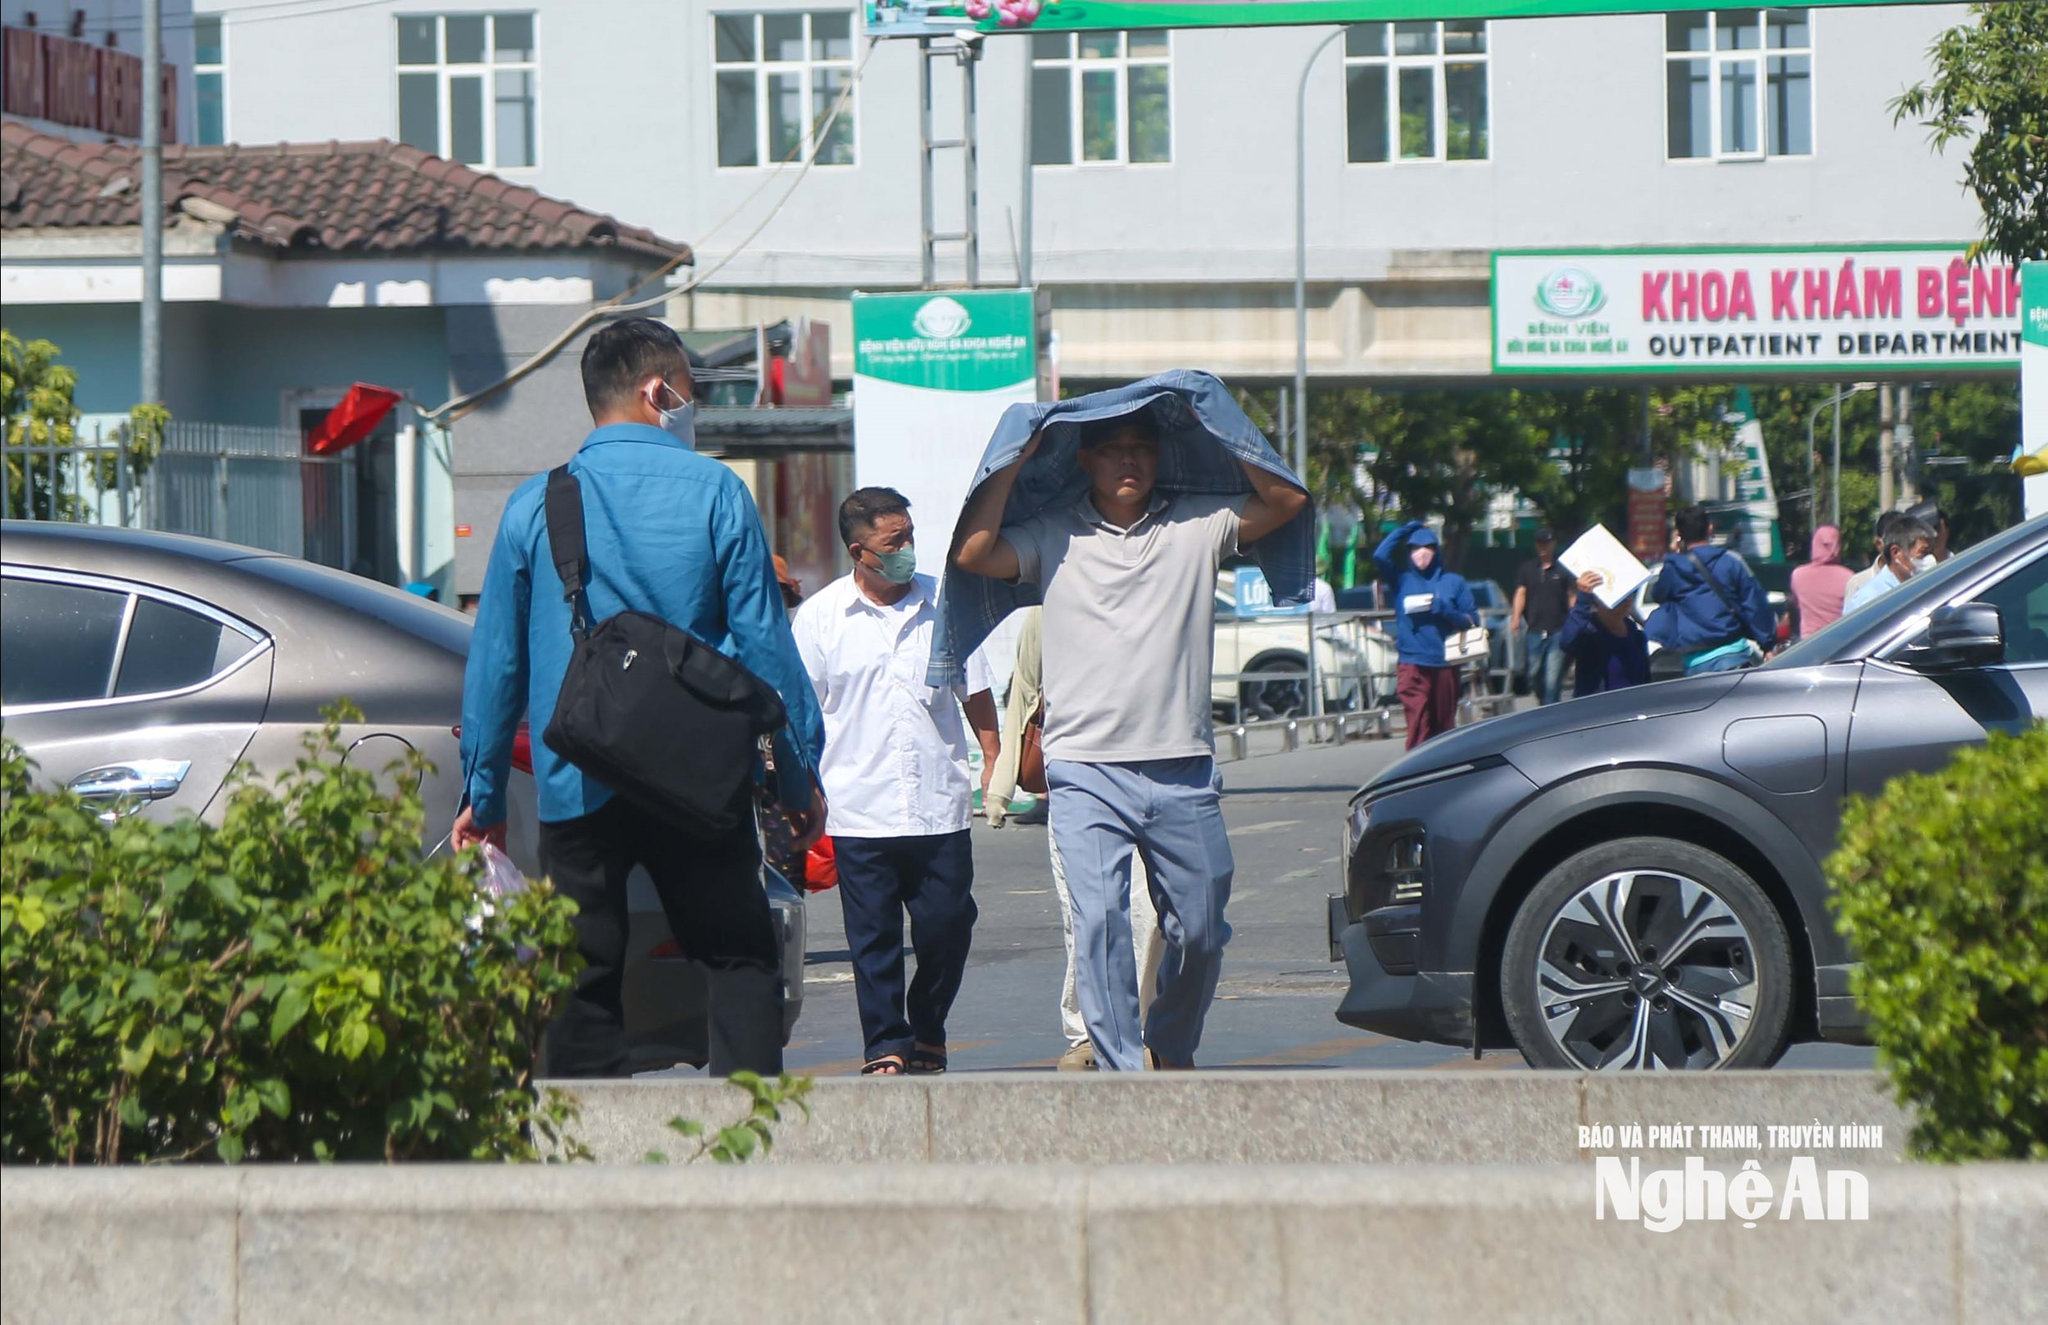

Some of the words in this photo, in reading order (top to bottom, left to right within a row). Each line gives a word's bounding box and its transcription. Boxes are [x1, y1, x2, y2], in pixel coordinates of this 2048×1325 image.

[1642, 269, 1757, 321] KHOA
[1771, 256, 1902, 320] KHÁM
[1649, 333, 1823, 357] OUTPATIENT
[1838, 331, 2022, 355] DEPARTMENT
